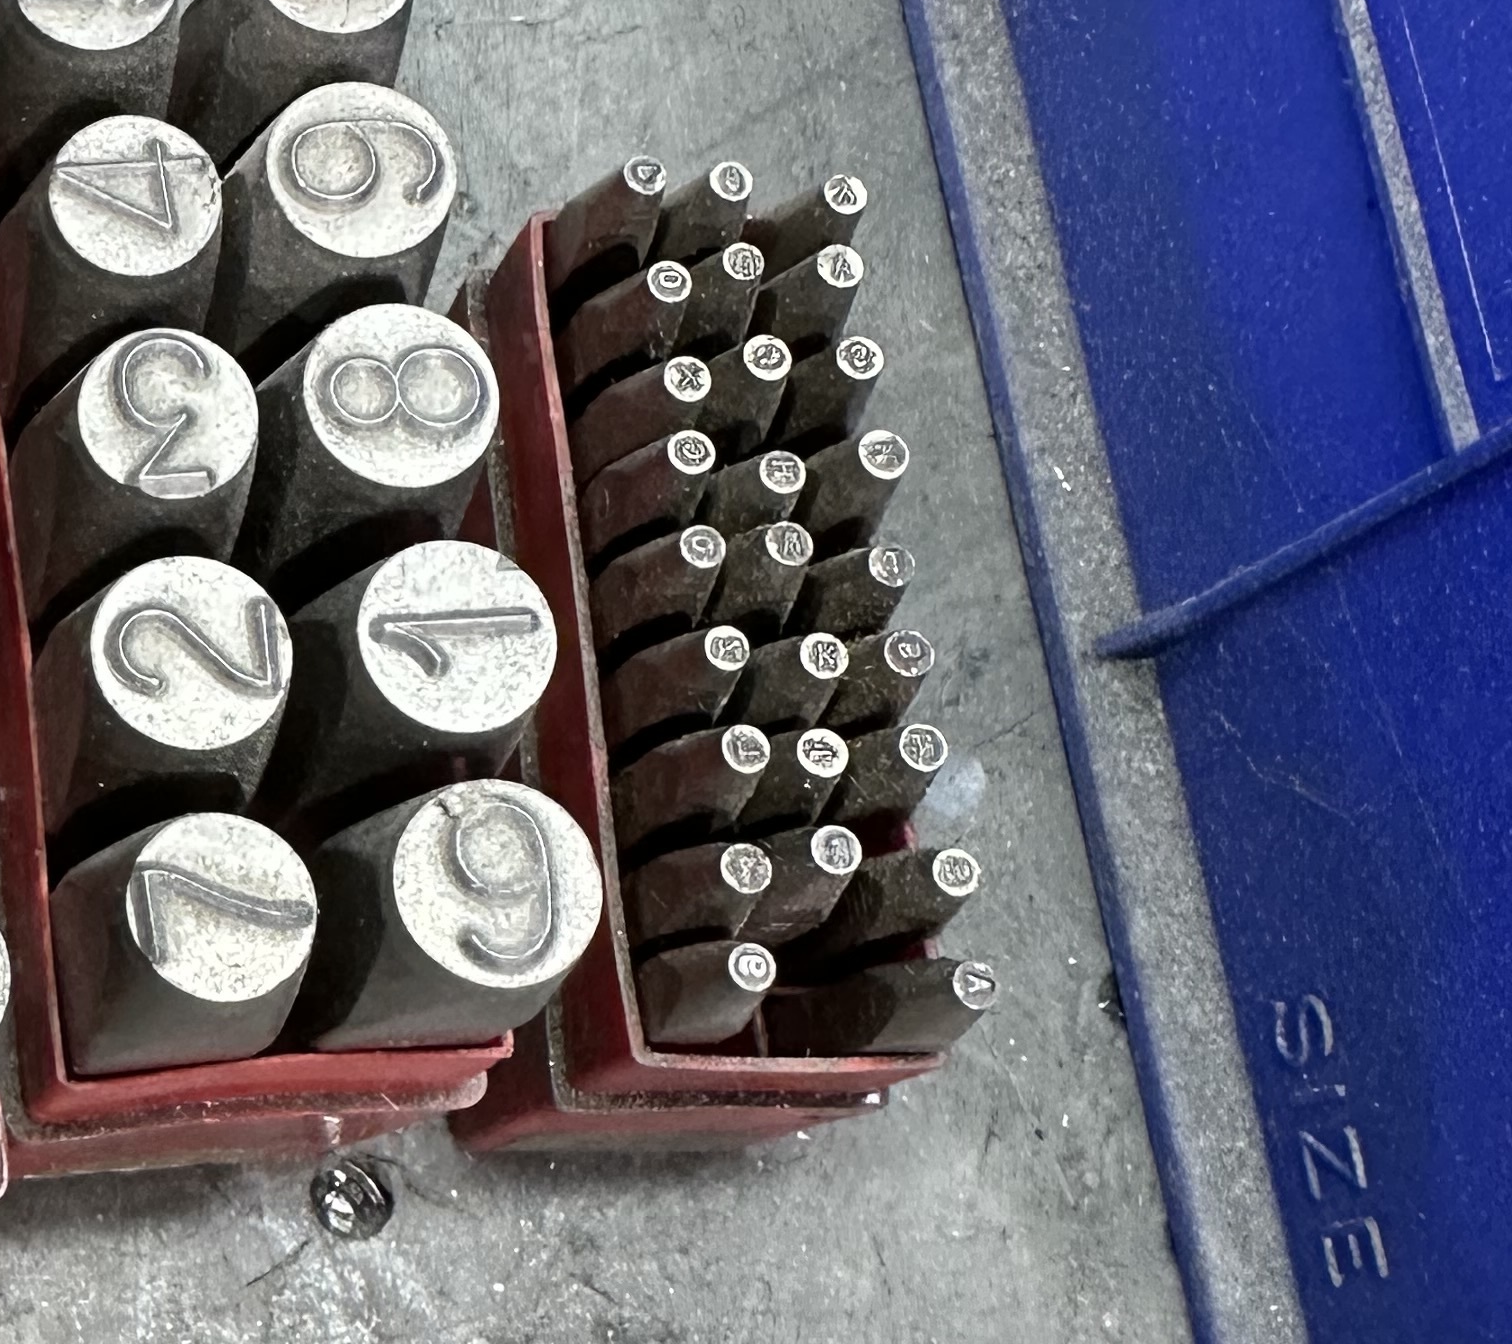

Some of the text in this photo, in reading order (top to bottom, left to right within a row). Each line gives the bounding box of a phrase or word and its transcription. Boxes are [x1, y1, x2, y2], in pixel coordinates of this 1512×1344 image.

[52, 138, 217, 234] 4
[322, 343, 488, 435] 8
[1273, 993, 1389, 1289] SIZE
